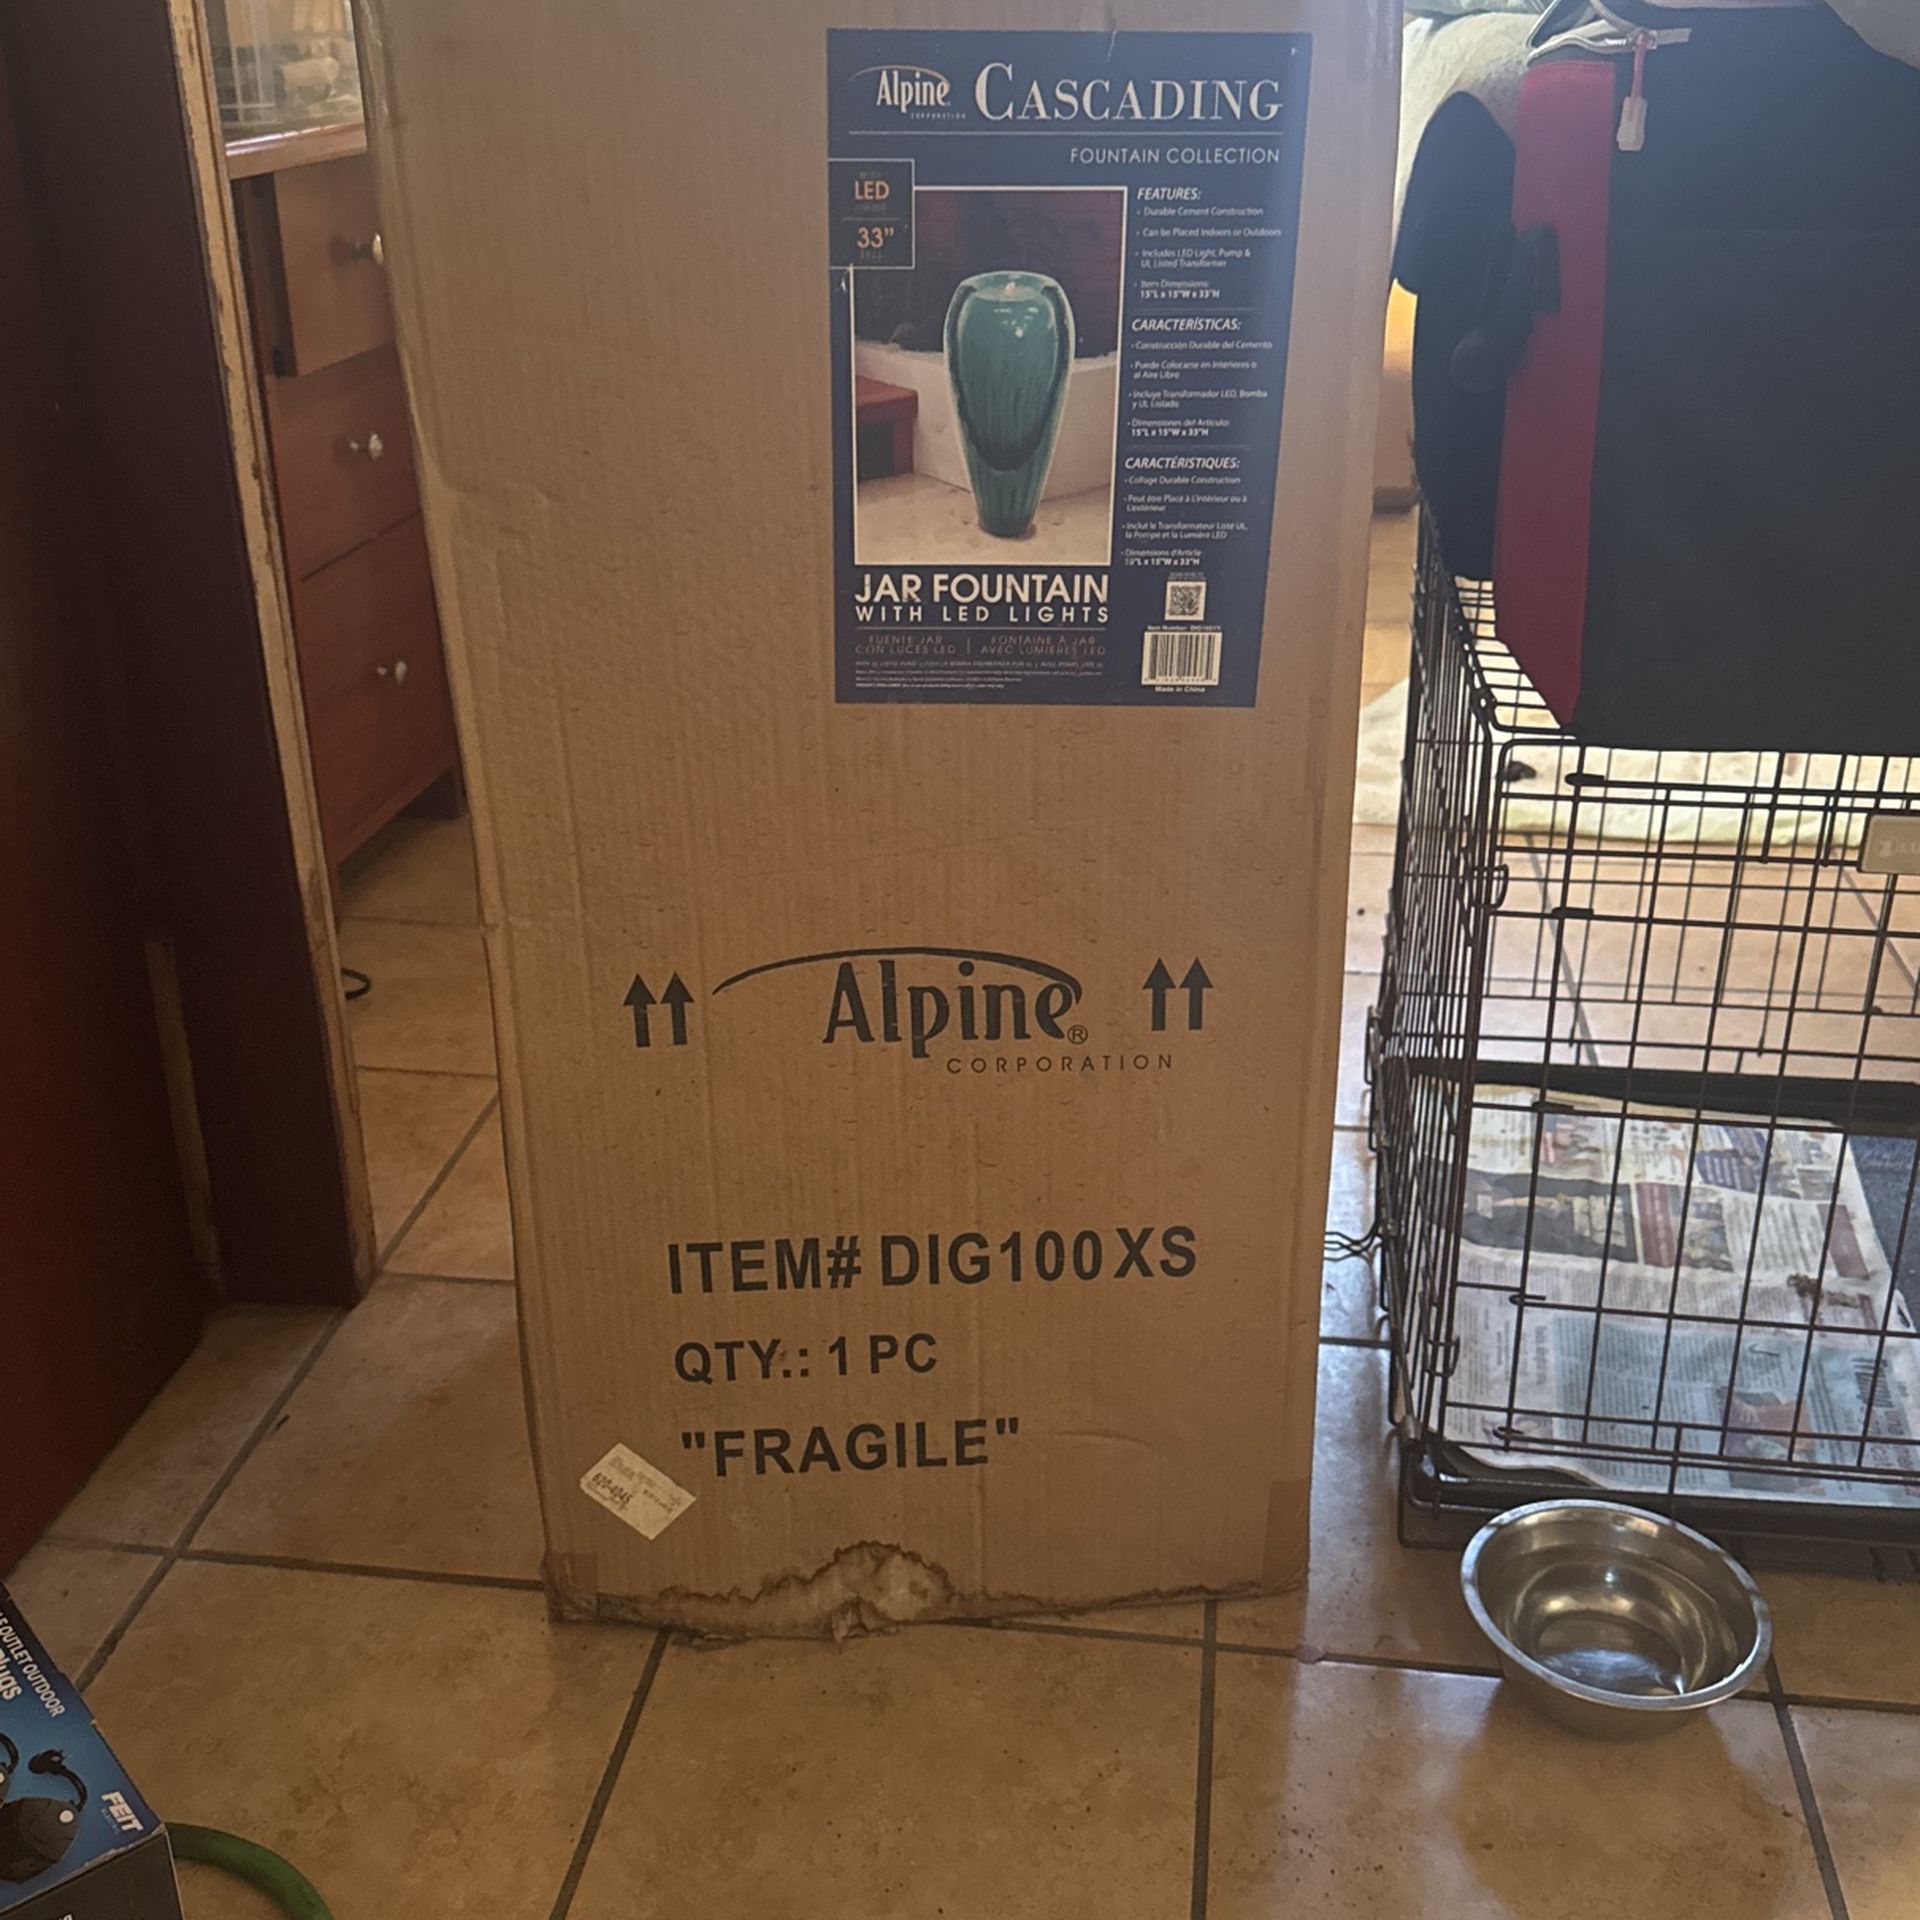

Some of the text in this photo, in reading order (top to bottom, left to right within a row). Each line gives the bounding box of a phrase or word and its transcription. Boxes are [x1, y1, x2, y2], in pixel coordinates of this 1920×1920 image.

[876, 69, 951, 113] Alpine
[974, 61, 1284, 122] CASCADING
[1069, 147, 1281, 164] FOUNTAIN COLLECTION
[854, 180, 890, 200] LED
[1137, 187, 1202, 200] FEATURES:
[1144, 207, 1264, 216] Durable Cement Construction
[1142, 228, 1159, 237] Can
[1160, 228, 1170, 237] be
[1172, 228, 1199, 237] Placed
[1201, 228, 1231, 237] Indoors
[1243, 228, 1282, 237] Outdoors
[1142, 248, 1177, 258] Includes
[1218, 248, 1243, 259] Pump
[1179, 259, 1228, 268] Transformer
[1131, 317, 1242, 332] CARACTERÍSTICAS:
[1188, 341, 1220, 350] Durable
[1221, 341, 1234, 350] del
[1236, 341, 1273, 350] Cemento
[1134, 360, 1159, 369] Puede
[1160, 360, 1199, 369] Colocarse
[1200, 360, 1211, 369] en
[1142, 371, 1158, 379] Aire
[1162, 391, 1219, 400] Transformador
[1124, 456, 1242, 470] CARACTÉRISTIQUES:
[1190, 475, 1241, 485] Construction
[855, 573, 1110, 604] JAR FOUNTAIN
[855, 605, 1109, 623] WITH LED LIGHTS
[822, 959, 1074, 1059] Alpine
[946, 1053, 1173, 1075] CORPORATION
[667, 1226, 1198, 1294] ITEM# DIG100XS
[674, 1332, 938, 1385] QTY.: 1 PC
[680, 1416, 1020, 1477] "FRAGILE"
[0, 1625, 66, 1718] OUTLET OUTDOOR
[101, 1790, 144, 1832] FEIT
